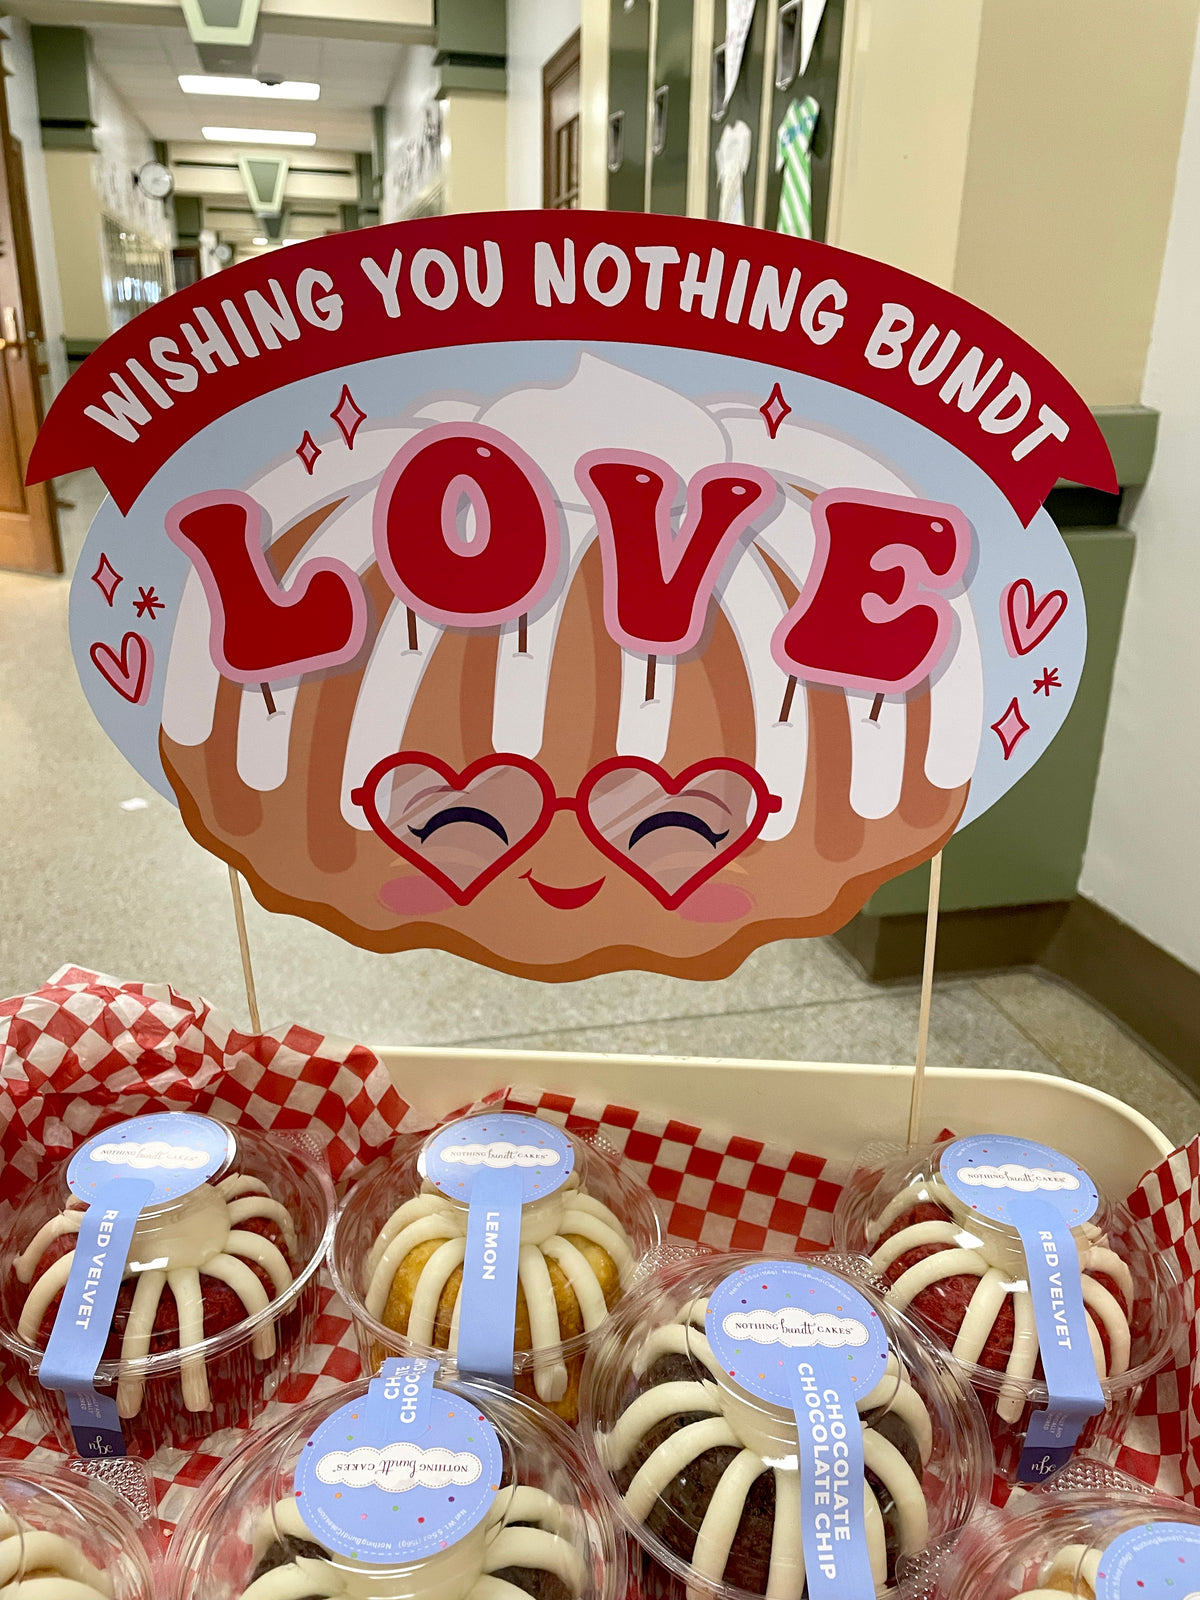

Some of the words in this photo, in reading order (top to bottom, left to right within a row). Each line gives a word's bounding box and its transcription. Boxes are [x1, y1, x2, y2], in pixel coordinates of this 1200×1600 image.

[84, 268, 343, 443] WISHING
[361, 240, 503, 319] YOU
[534, 238, 847, 346] NOTHING
[864, 302, 1070, 462] BUNDT
[165, 421, 972, 694] LOVE
[97, 1210, 119, 1248] RED
[482, 1211, 501, 1280] LEMON
[1038, 1231, 1059, 1267] RED
[75, 1252, 106, 1331] VELVET
[1048, 1271, 1072, 1350] VELVET
[735, 1322, 779, 1331] NOTHING
[780, 1318, 817, 1336] bundt
[817, 1326, 852, 1335] CAKES
[335, 1463, 376, 1472] CAKES
[376, 1459, 418, 1479] bundt
[419, 1464, 469, 1473] NOTHING
[797, 1362, 830, 1506] CHOCOLATE
[814, 1512, 837, 1580] CHIP
[822, 1388, 851, 1541] CHOCOLATE
